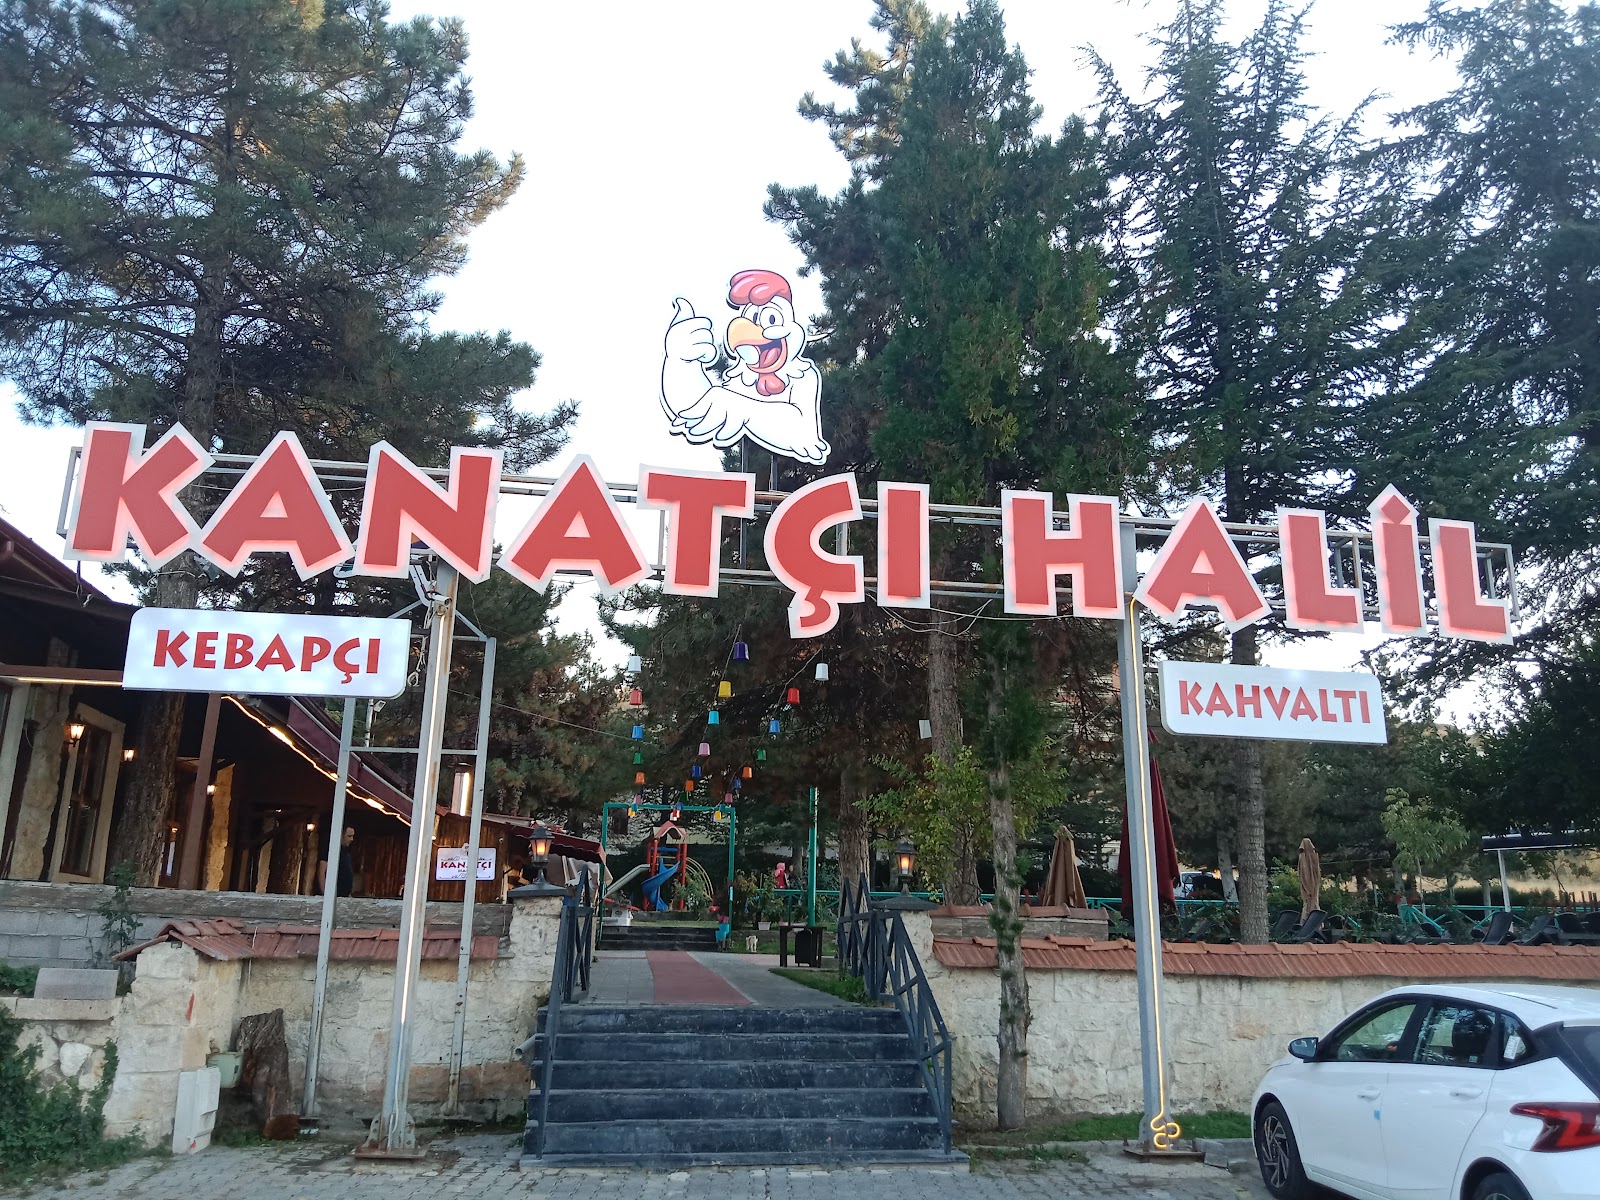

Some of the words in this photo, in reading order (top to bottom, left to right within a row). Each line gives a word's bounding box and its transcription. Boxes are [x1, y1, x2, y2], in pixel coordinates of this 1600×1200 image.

[70, 426, 925, 631] KANATÇI
[1010, 491, 1512, 638] HALİL
[153, 628, 380, 684] KEBAPÇI
[1178, 679, 1372, 725] KAHVALTI
[440, 861, 492, 871] KANTÇI
